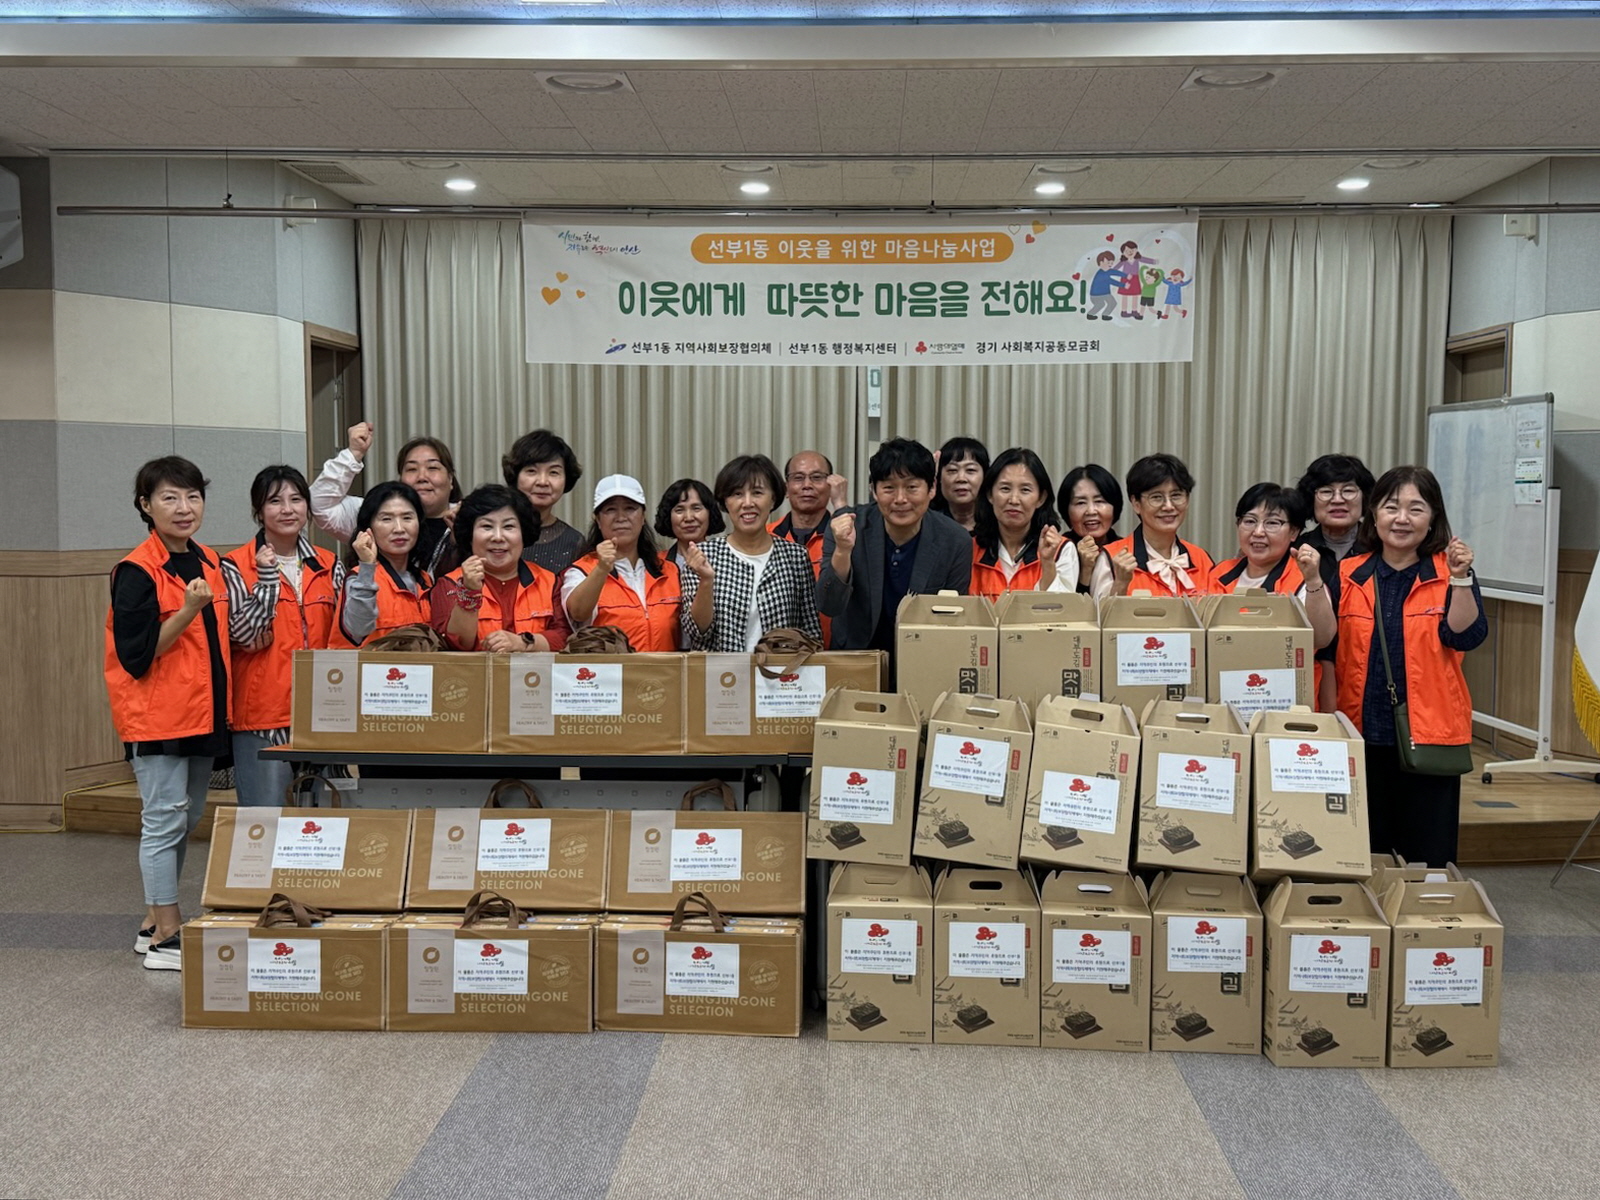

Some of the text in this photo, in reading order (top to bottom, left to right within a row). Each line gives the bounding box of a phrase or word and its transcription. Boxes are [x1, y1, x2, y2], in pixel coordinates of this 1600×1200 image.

[708, 238, 996, 259] 선부1동 이웃을 위한 마음나눔사업
[618, 279, 1087, 319] 이웃에게 따뜻한 마음을 전해요!
[631, 341, 772, 355] 선부1동 지역사회보장협의체
[788, 342, 897, 355] 선부1동 행정복지센터
[976, 340, 1100, 354] 경기 사회복지공동모금회
[362, 712, 465, 722] CHUNGJUNGONE
[560, 713, 663, 724] CHUNGJUNGONE
[362, 722, 425, 733] SELECTION
[560, 724, 623, 735] SELECTION
[278, 867, 383, 878] CHUNGJUNGONE
[480, 868, 585, 879] CHUNGJUNGONE
[277, 878, 341, 889] SELECTION
[480, 879, 543, 890] SELECTION
[678, 882, 741, 893] SELECTION
[255, 990, 362, 1001] CHUNGJUNGONE
[460, 991, 568, 1002] CHUNGJUNGONE
[669, 995, 776, 1007] CHUNGJUNGONE
[255, 1001, 320, 1012] SELECTION
[461, 1002, 526, 1014] SELECTION
[669, 1004, 734, 1017] SELECTION
